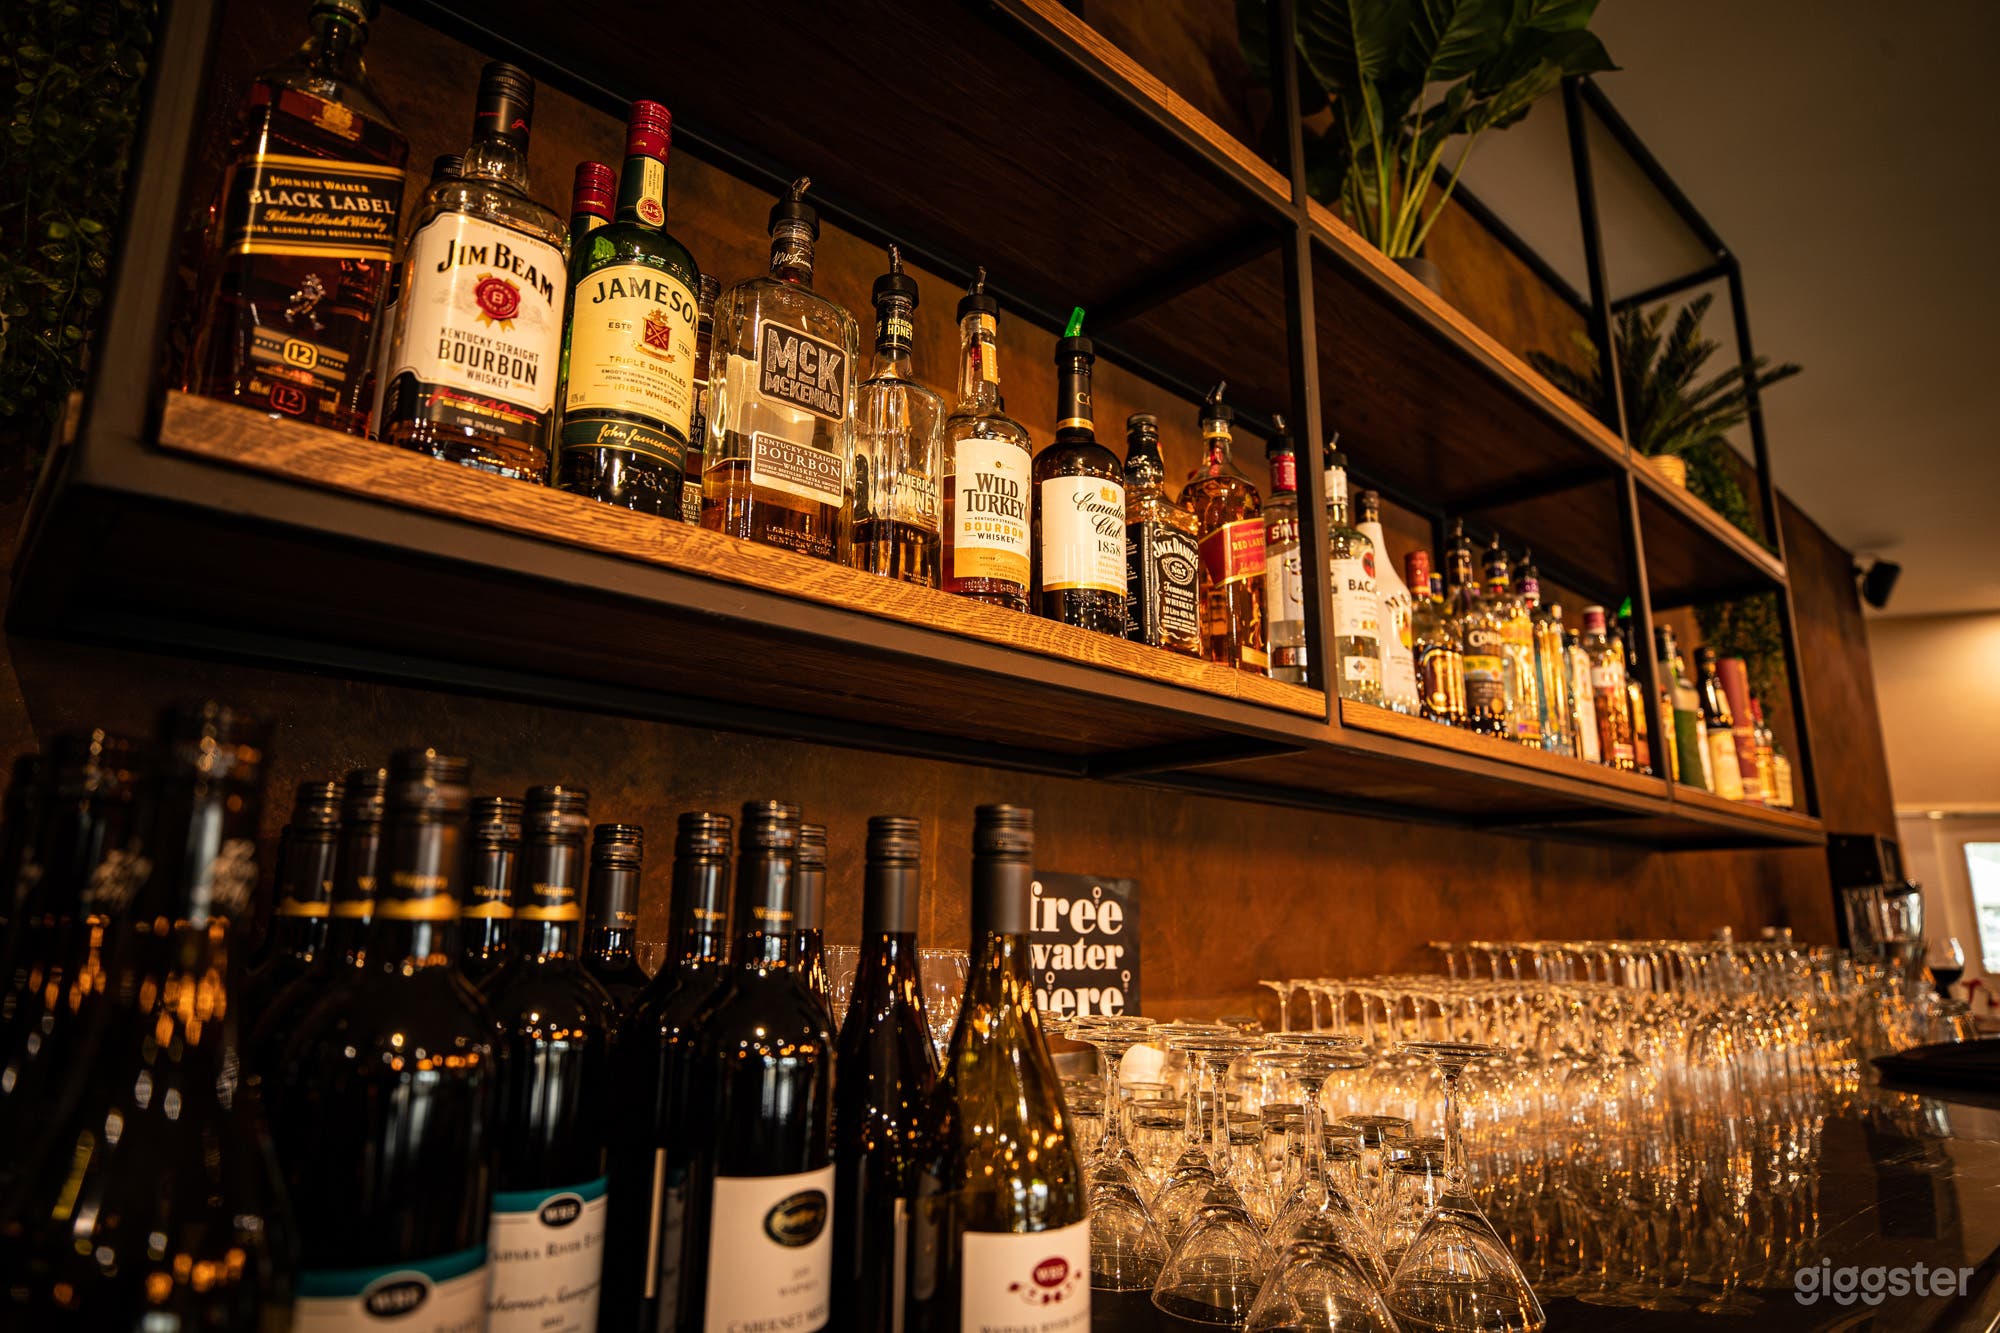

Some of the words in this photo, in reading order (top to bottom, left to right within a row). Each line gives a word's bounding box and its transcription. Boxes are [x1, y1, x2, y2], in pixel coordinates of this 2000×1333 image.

[249, 188, 324, 209] BLACK
[329, 195, 396, 215] LABEL
[437, 239, 487, 273] JIM
[493, 242, 554, 308] BEAM
[290, 344, 312, 365] 12
[440, 326, 492, 348] KENTUCKY
[496, 341, 539, 363] STRAIGHT
[438, 338, 538, 386] BOURBON
[610, 355, 646, 369] TRIPLE
[466, 369, 510, 389] WHISKEY
[614, 383, 643, 395] IRISH
[645, 388, 682, 413] WHISKEY
[758, 436, 802, 454] KENTUCKY
[804, 450, 842, 467] STRAIGHT
[758, 443, 841, 478] BOURBON
[783, 463, 818, 479] WHISKEY
[976, 472, 1020, 499] WILD
[963, 489, 1025, 521] TURKEY
[964, 521, 1024, 540] BOURBON
[978, 532, 1015, 545] WHISKEY
[1091, 514, 1122, 539] Club
[1098, 540, 1121, 557] 1858
[1152, 540, 1173, 558] JACK
[1164, 597, 1194, 611] WHISKEY
[1029, 880, 1124, 936] free
[1031, 936, 1124, 971] water
